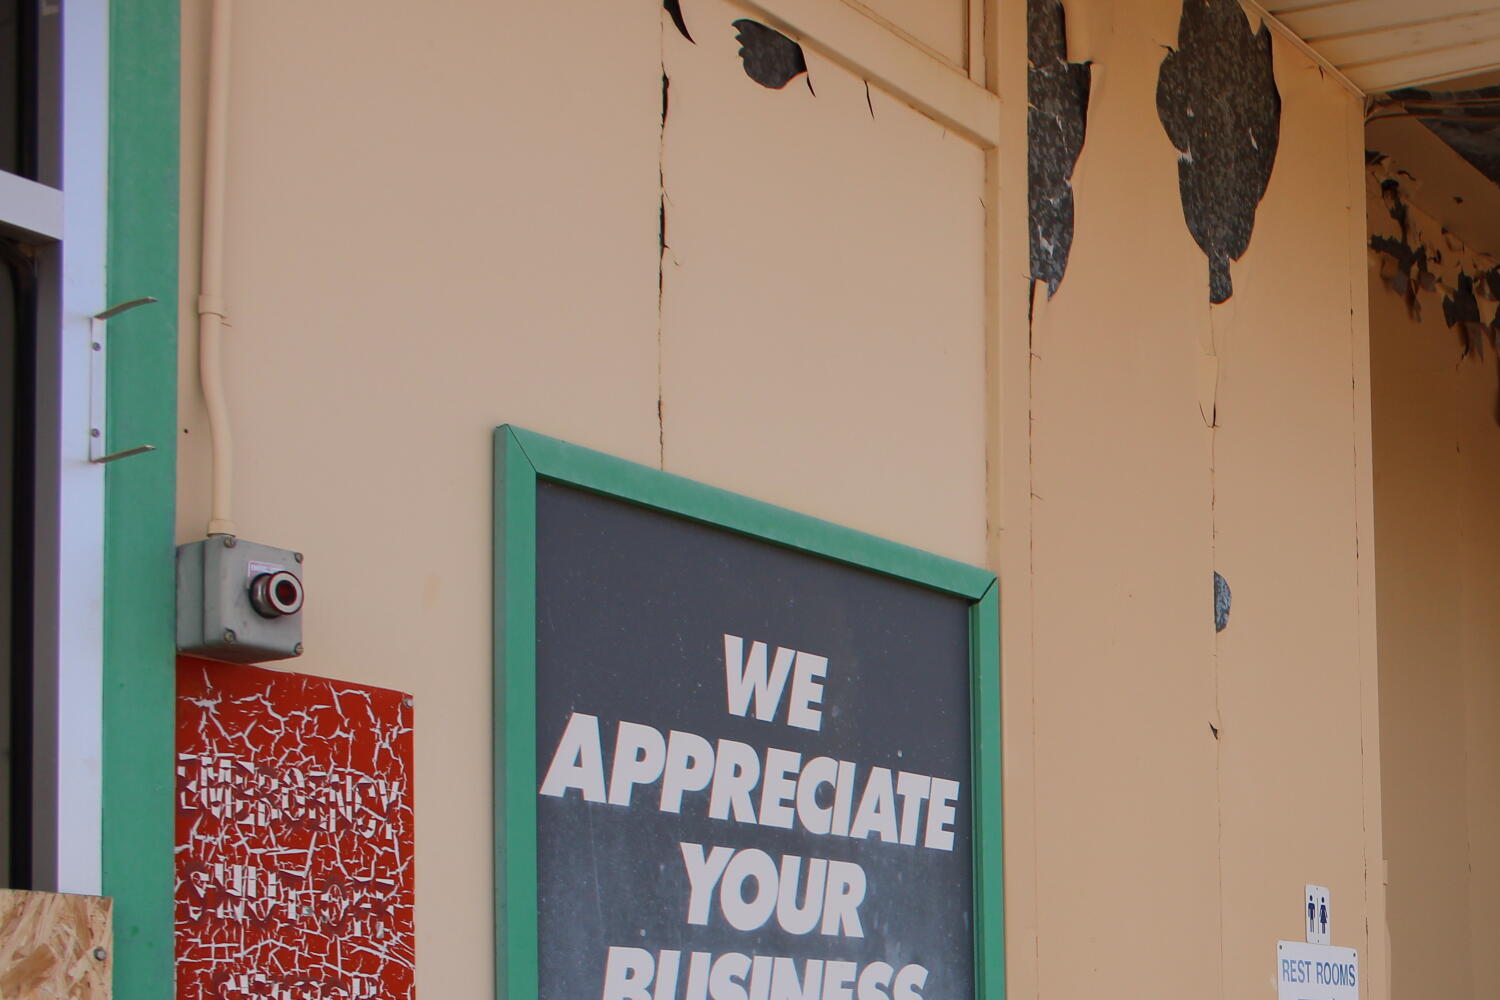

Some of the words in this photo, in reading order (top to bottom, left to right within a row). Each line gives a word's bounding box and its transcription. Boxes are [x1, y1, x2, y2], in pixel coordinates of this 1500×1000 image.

[723, 633, 829, 732] WE
[178, 752, 401, 840] EMERGENCY
[539, 712, 960, 851] APPRECIATE
[680, 842, 865, 938] YOUR
[1281, 959, 1312, 983] REST
[1316, 962, 1356, 987] ROOMS
